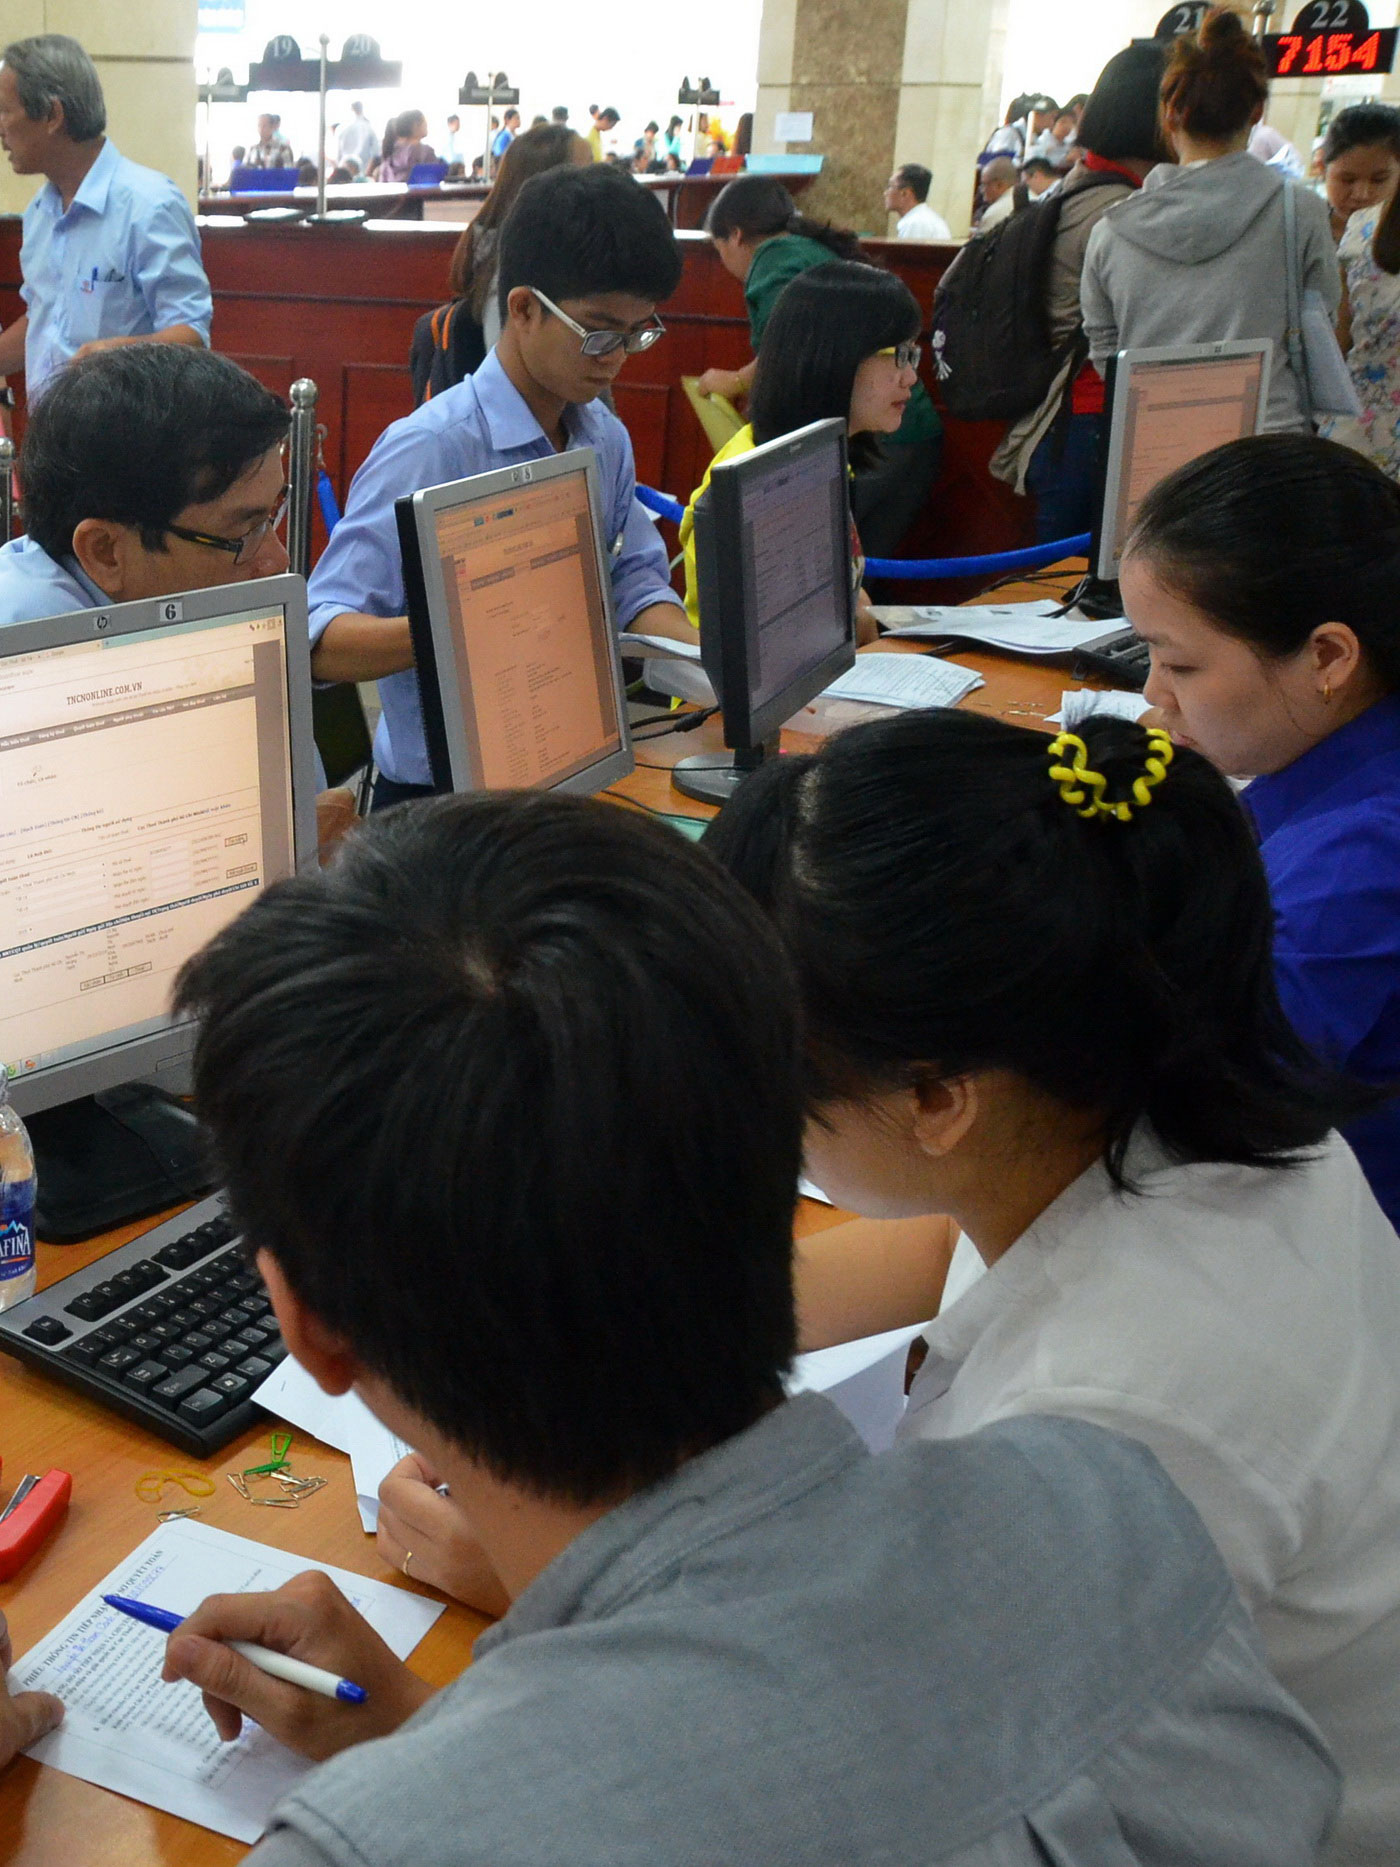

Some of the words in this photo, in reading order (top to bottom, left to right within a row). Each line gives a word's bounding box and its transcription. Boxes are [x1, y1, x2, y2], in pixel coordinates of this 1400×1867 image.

[1174, 7, 1204, 34] 21
[1311, 0, 1349, 29] 22
[273, 35, 293, 57] 19
[1277, 32, 1380, 73] 7154
[165, 603, 177, 620] 6
[67, 681, 143, 705] TNCNONLINE.COM.VN
[44, 1642, 69, 1666] THÔNG
[66, 1633, 79, 1645] TIN
